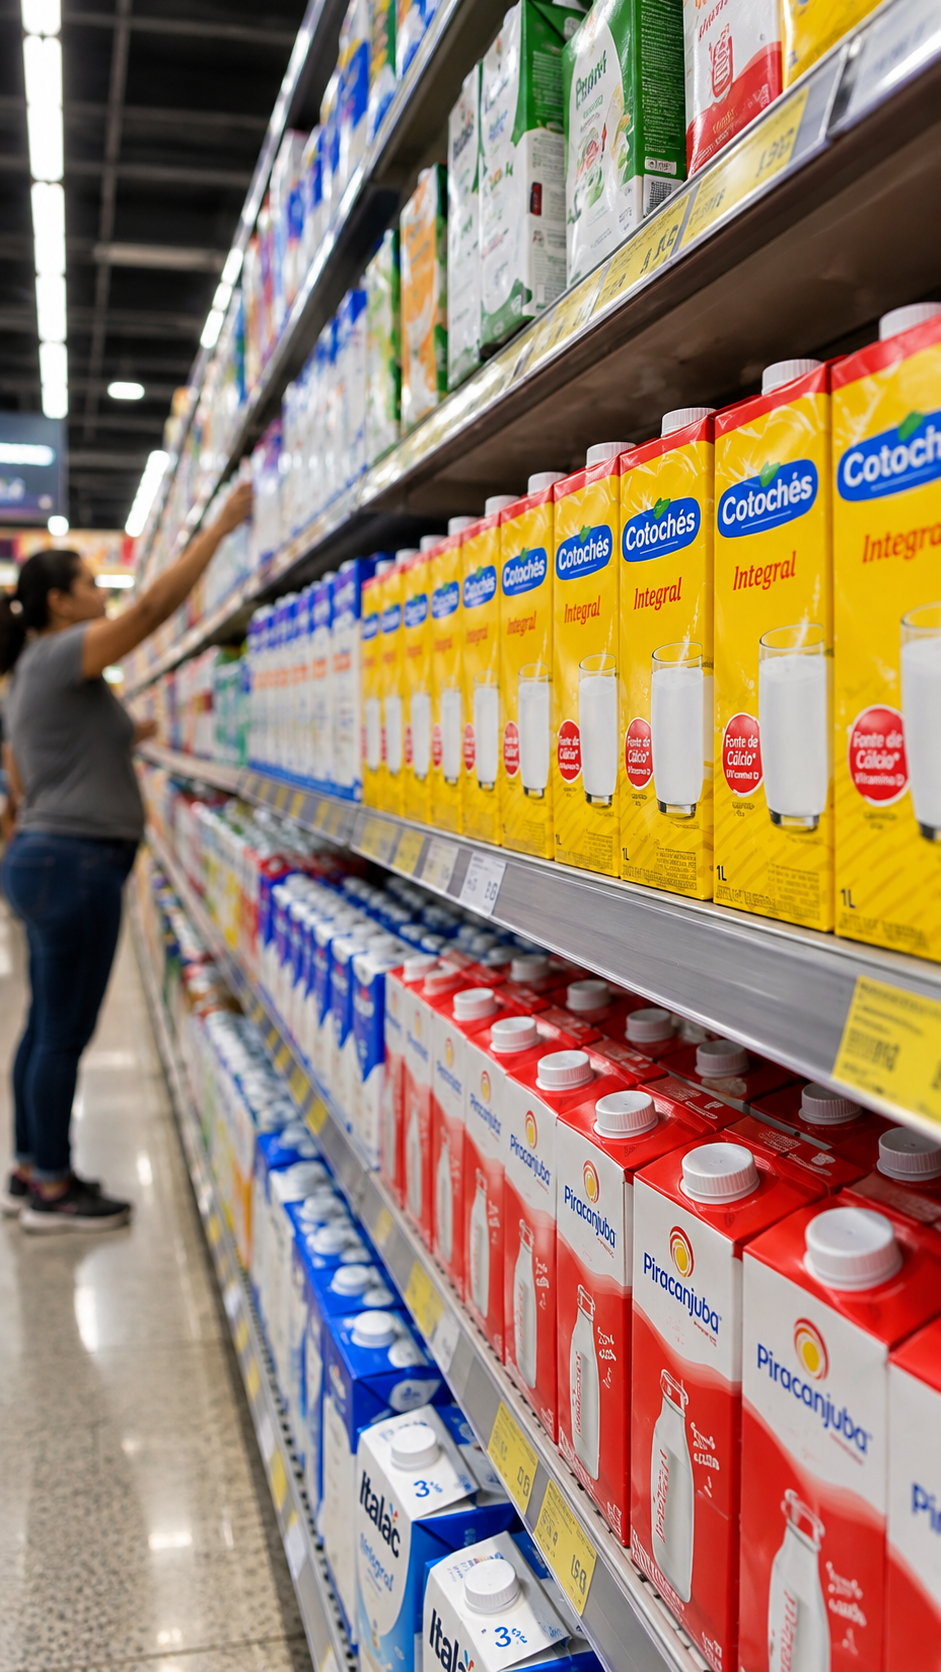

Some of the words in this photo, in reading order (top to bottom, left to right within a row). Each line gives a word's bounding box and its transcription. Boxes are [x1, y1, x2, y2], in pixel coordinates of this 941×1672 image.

[722, 472, 813, 525] Cotochés
[626, 509, 695, 551] Cotochés
[503, 556, 545, 588] Cotochés
[558, 534, 609, 571] Cotochés
[733, 550, 797, 591] Integral
[564, 594, 601, 625] Integral
[633, 576, 683, 611] Integral
[725, 734, 747, 748] Fonte
[747, 734, 759, 748] de
[853, 730, 885, 748] Fonte
[886, 729, 903, 748] de
[716, 865, 728, 882] 1L
[841, 888, 857, 909] 1L
[510, 1134, 551, 1186] Piracanjuba
[564, 1185, 617, 1248] Piracanjuba
[643, 1252, 720, 1335] Piracanjuba
[757, 1343, 870, 1456] Piracanjuba
[359, 1468, 401, 1559] Italac
